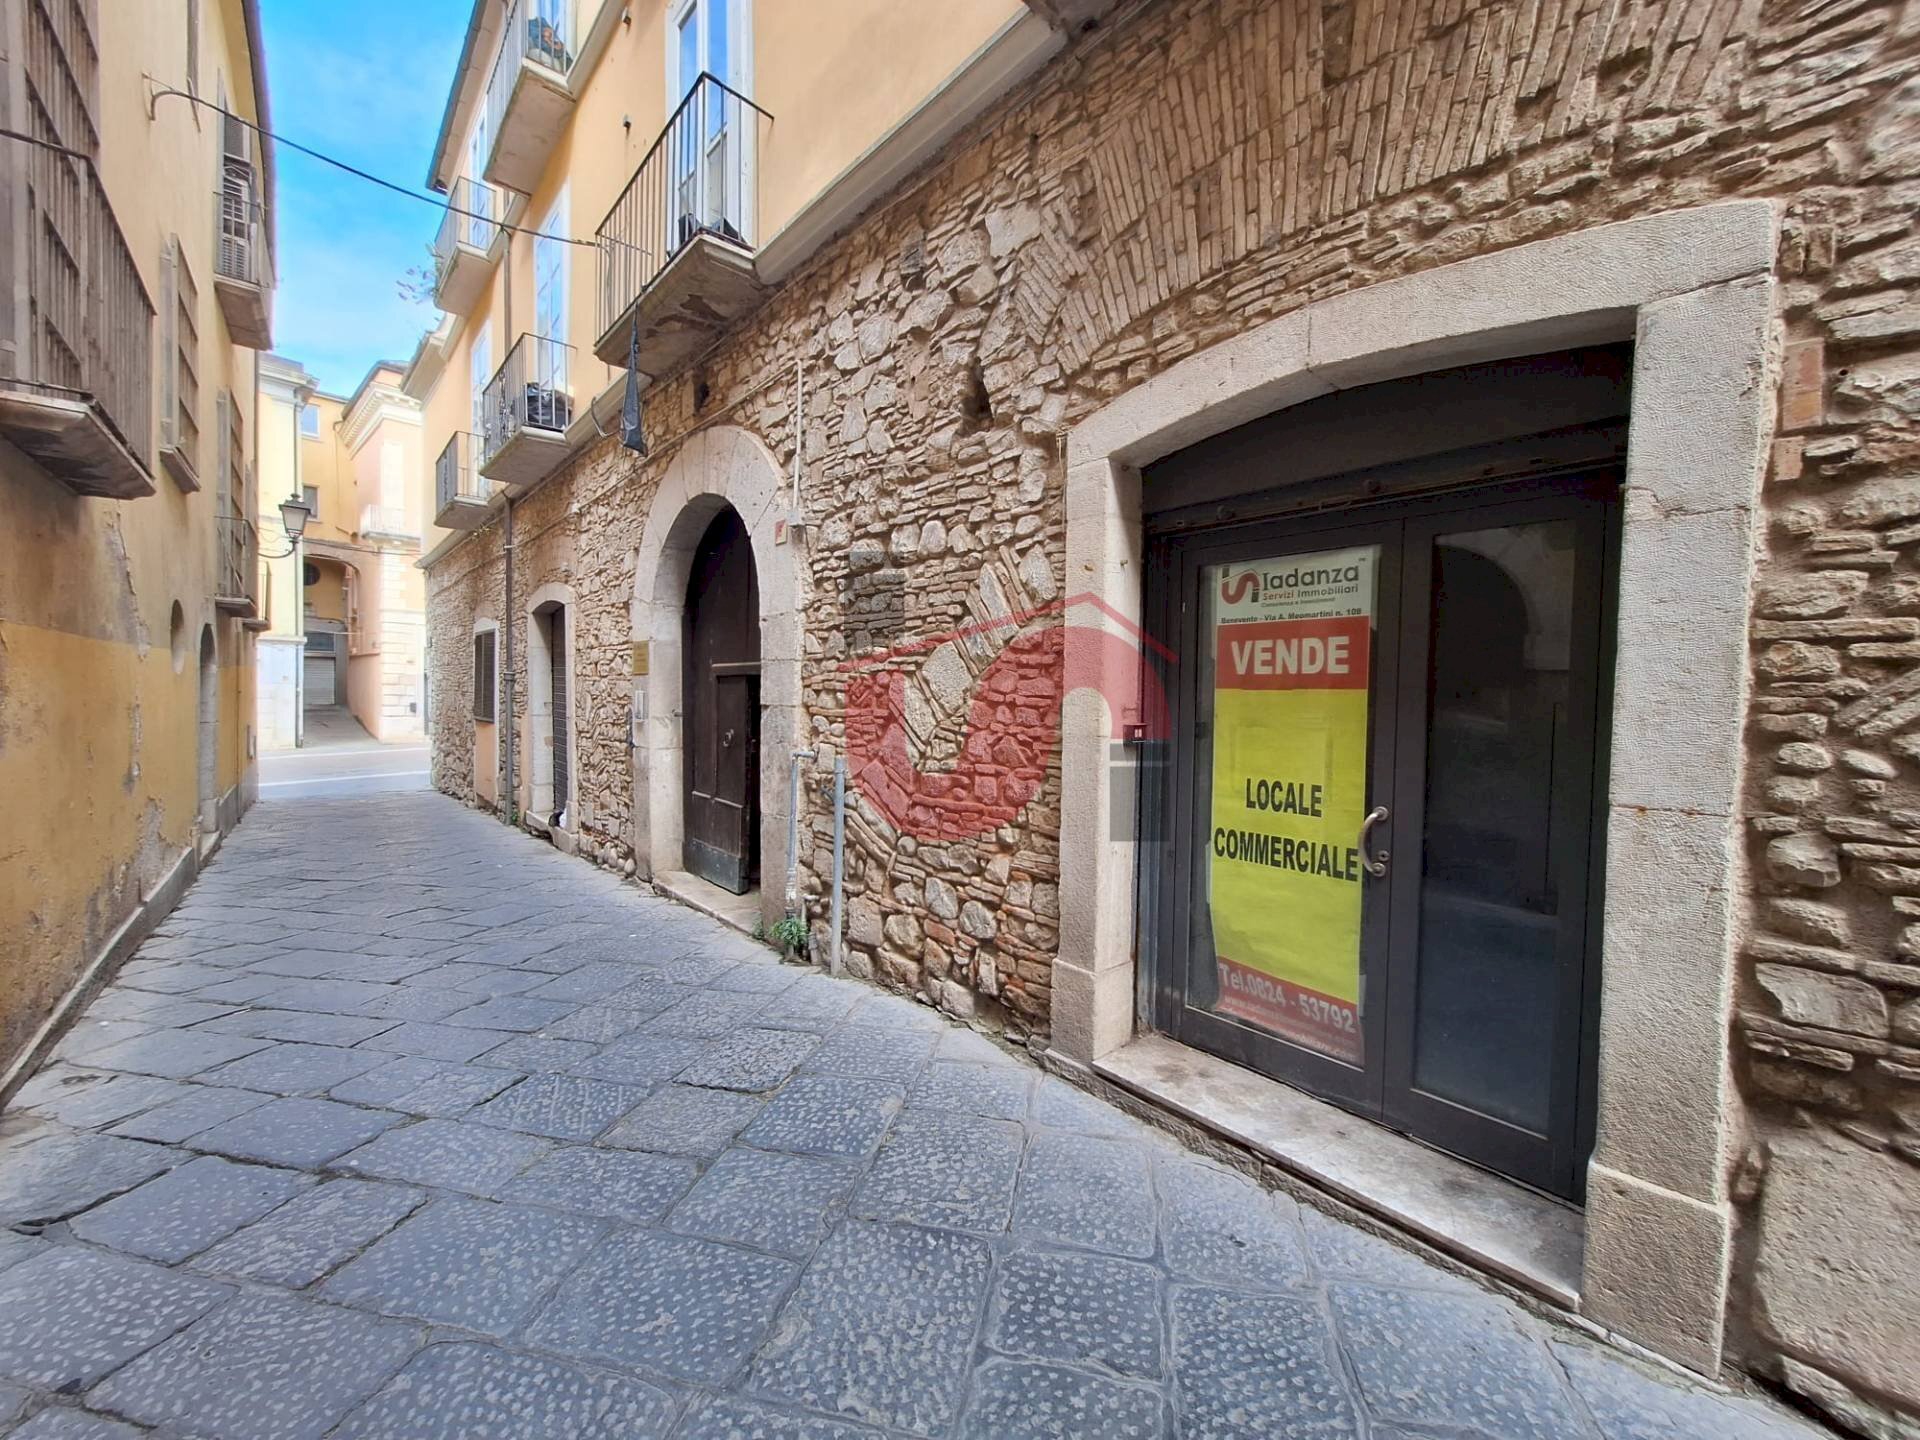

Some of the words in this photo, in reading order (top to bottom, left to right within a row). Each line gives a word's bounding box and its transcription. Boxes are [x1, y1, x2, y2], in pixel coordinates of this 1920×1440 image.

[1263, 566, 1360, 591] Iadanza
[1263, 590, 1295, 601] Servizi
[1297, 584, 1359, 598] Immobiliari
[1231, 636, 1350, 675] VENDE
[1246, 778, 1322, 818] LOCALE
[1214, 827, 1359, 882] COMMERCIALE
[1298, 993, 1357, 1034] 53792
